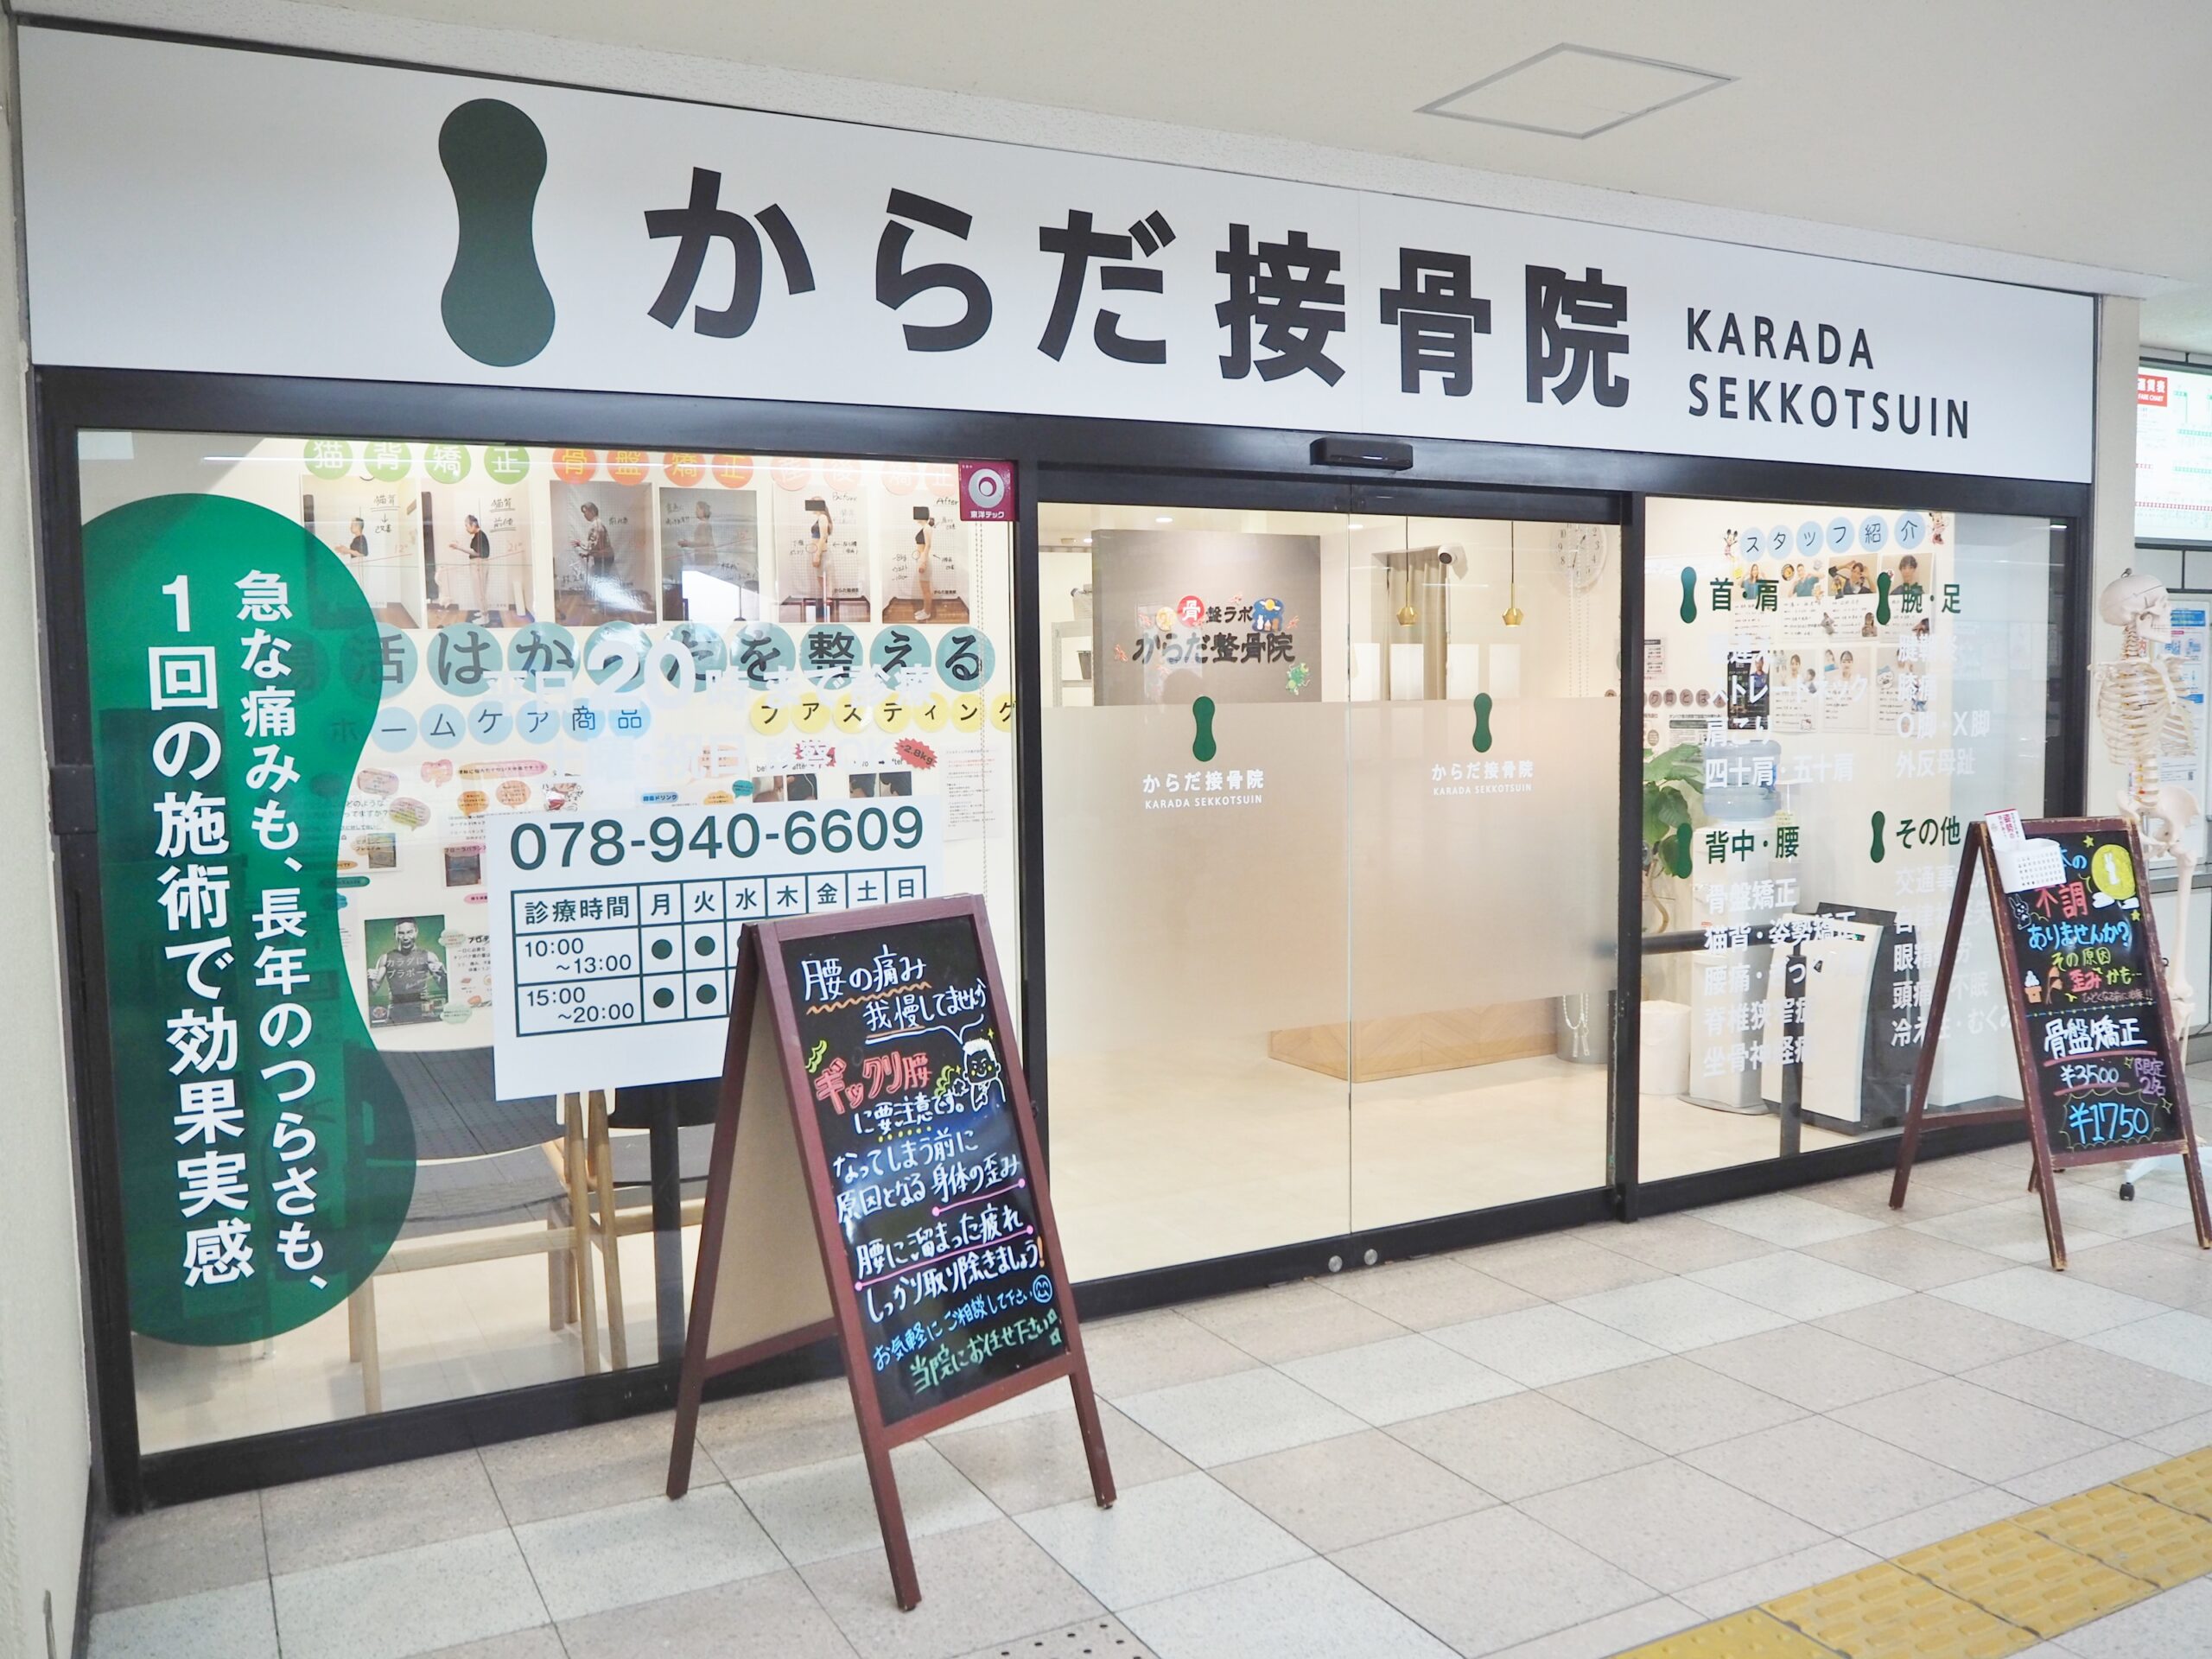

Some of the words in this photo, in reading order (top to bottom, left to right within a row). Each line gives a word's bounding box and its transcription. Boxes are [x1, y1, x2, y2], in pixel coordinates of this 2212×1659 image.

[644, 167, 1630, 408] からだ接骨院
[1688, 307, 1874, 370] KARADA
[1688, 373, 1968, 439] SEKKOTSUIN
[313, 442, 521, 474] 猫背矯正
[563, 448, 746, 479] 骨盤矯正
[937, 497, 958, 505] After
[1746, 519, 1920, 554] スタッフ紹介
[1710, 577, 1778, 612] 首・肩
[1901, 583, 1961, 614] 腕・足
[1182, 601, 1253, 624] 骨盤ラボ
[1132, 632, 1296, 664] からだ整骨院
[1706, 715, 1770, 748] 肩こり
[899, 742, 934, 765] -2.8kg
[1705, 753, 1855, 788] 四十肩・五十肩
[1896, 747, 1976, 779] 外反母趾
[1142, 769, 1264, 793] からだ接骨院
[1432, 760, 1534, 782] からだ接骨院
[1145, 798, 1190, 810] KARADA
[1195, 794, 1262, 807] SEKKOTSUIN
[1433, 785, 1471, 796] KARADA
[1475, 783, 1531, 794] SEKKOTSUIN
[511, 807, 924, 871] 078-940-6609
[1706, 826, 1800, 864] 背中・腰
[1897, 817, 1961, 849] その他
[525, 896, 629, 925] 診療時間
[651, 893, 670, 916] 月
[694, 891, 715, 913] 火
[735, 888, 758, 910] 水
[777, 885, 798, 906] 木
[817, 882, 838, 905] 金
[857, 880, 878, 902] 土
[898, 879, 914, 899] 日
[1706, 878, 1797, 914] 骨盤矯正
[2035, 881, 2088, 919] 不調
[148, 575, 255, 1287] 1回の施術で効果実感
[234, 569, 327, 1290] 急な痛みも、長年のつらさも、
[2028, 921, 2132, 950] ありませんか?
[524, 938, 584, 957] 10:00
[1893, 937, 1972, 972] 眼精労
[2051, 946, 2111, 971] その原因
[801, 944, 926, 1001] 腰の痛み
[2069, 968, 2102, 993] 歪み
[527, 987, 586, 1007] 15:00
[2043, 1017, 2148, 1060] 骨盤矯正
[814, 1051, 932, 1115] ギックリ腰
[2060, 1065, 2119, 1089] ¥3500
[2134, 1058, 2167, 1077] 限定
[2139, 1077, 2166, 1096] 2名
[854, 1090, 964, 1135] に要注意です。
[2069, 1102, 2149, 1143] ¥1750
[833, 1127, 978, 1183] なってしまう前に
[856, 1203, 1024, 1279] 腰に溜まった疲れ
[910, 1318, 1049, 1395] 当院にお任せ下さい
